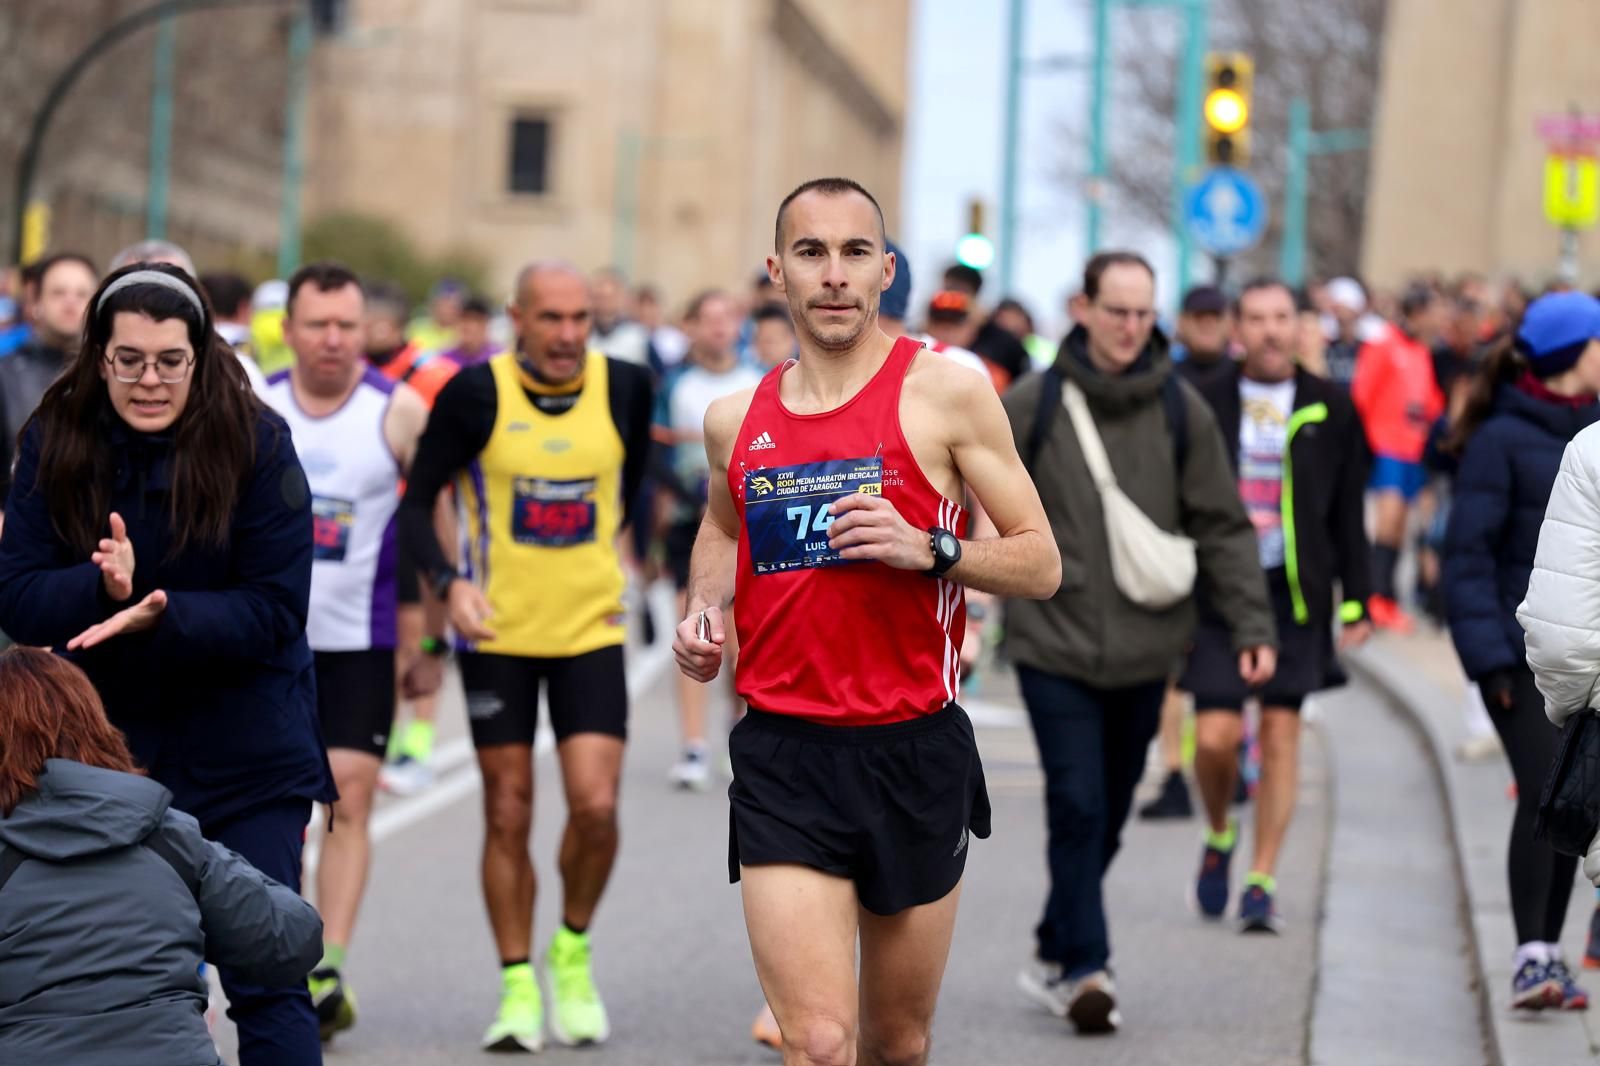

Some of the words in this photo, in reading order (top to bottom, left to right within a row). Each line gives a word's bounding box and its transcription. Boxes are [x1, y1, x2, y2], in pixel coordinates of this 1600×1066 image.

[748, 442, 776, 451] adidas
[777, 472, 794, 480] XXVII
[777, 479, 795, 488] RODI
[796, 477, 815, 486] MEDIA
[816, 473, 847, 483] MARATÓN
[847, 471, 879, 481] IBERCAJA
[776, 486, 799, 496] CIUDAD
[800, 485, 808, 493] DE
[809, 482, 842, 492] ZARAGOZA
[862, 485, 879, 494] 21k
[805, 541, 827, 552] LUIS
